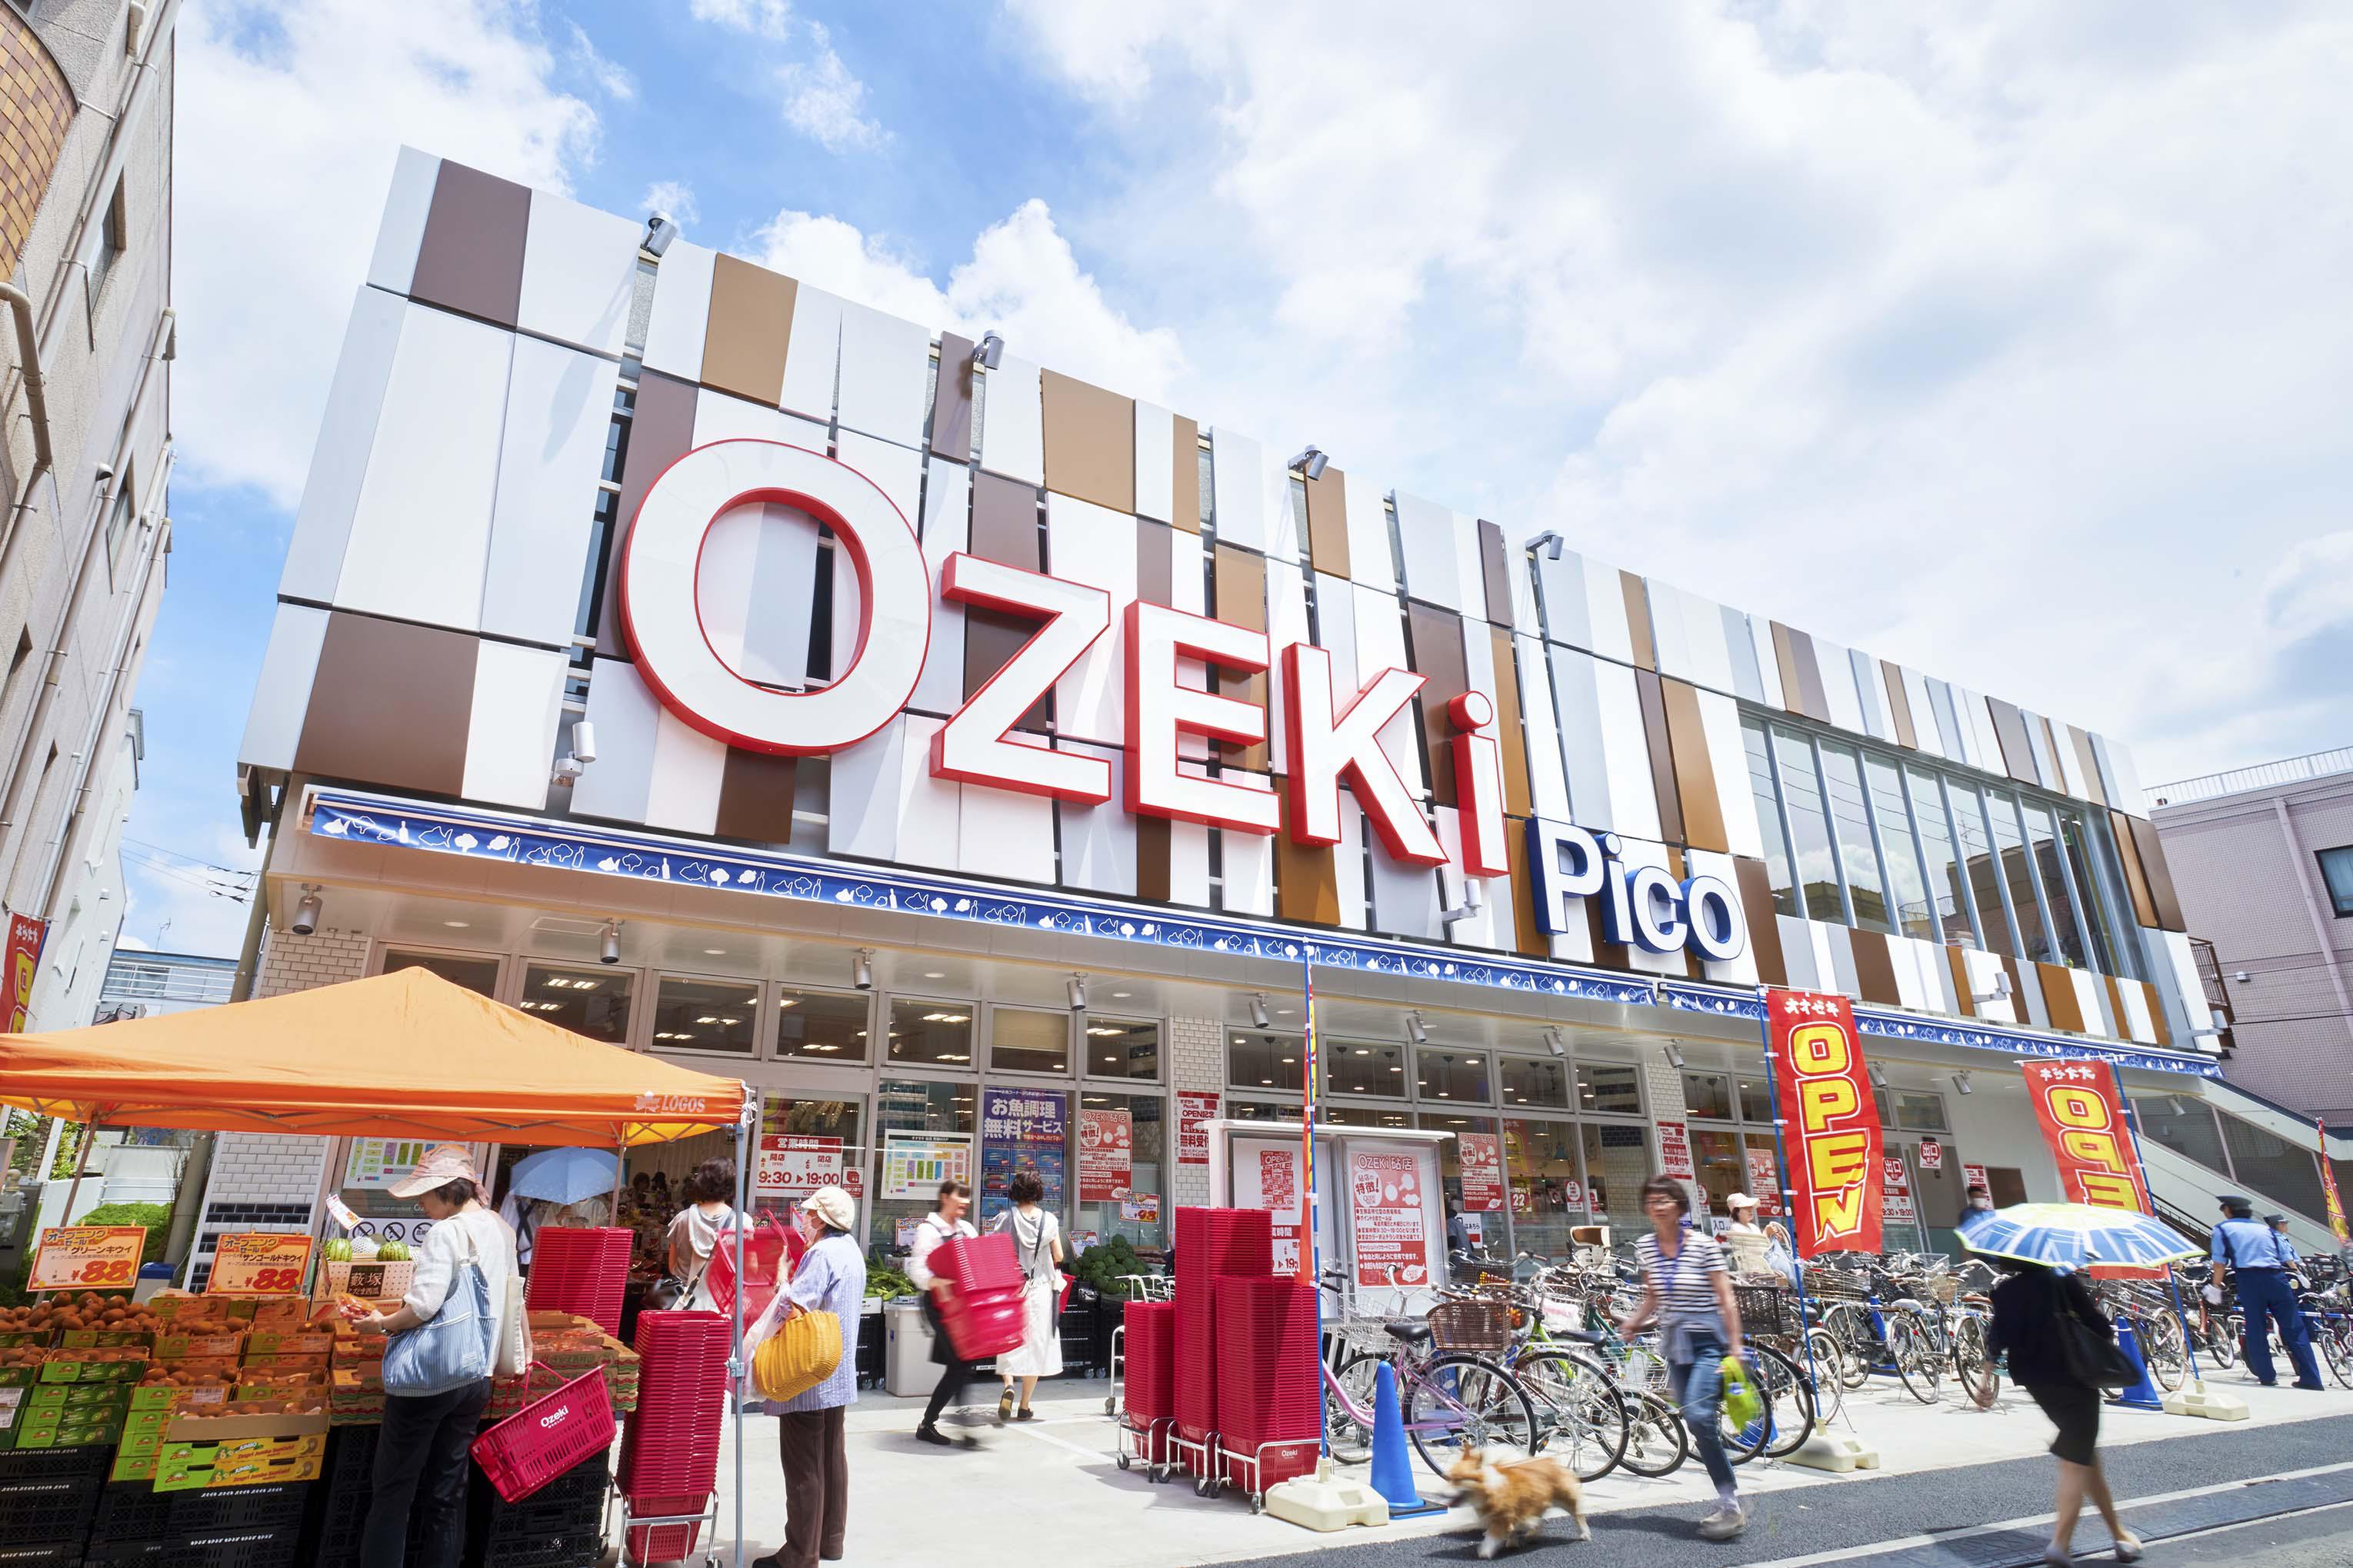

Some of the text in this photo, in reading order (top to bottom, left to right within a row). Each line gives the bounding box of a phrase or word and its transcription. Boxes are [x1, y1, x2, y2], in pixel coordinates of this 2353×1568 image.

[1528, 816, 1746, 960] Pico
[1784, 998, 1839, 1017] オオゼキ
[662, 1095, 705, 1113] LOGOS
[992, 1098, 1055, 1119] お魚調理
[1182, 1110, 1215, 1119] OPEN記念
[985, 1117, 1062, 1140] 無料 サービス
[1788, 1020, 1870, 1247] OPEN
[777, 1138, 819, 1150] 営業時間
[1921, 1143, 1939, 1157] 出口
[1391, 1156, 1412, 1170] 砧店
[1885, 1158, 1902, 1174] 出口
[758, 1171, 839, 1185] 9:30 19:00
[1513, 1193, 1525, 1206] 22
[1713, 1220, 1725, 1230] 入口
[47, 1230, 106, 1242] オープニング
[72, 1246, 132, 1254] グリーンキウイ
[224, 1238, 278, 1249] オープニング
[541, 1405, 568, 1428] Ozeki
